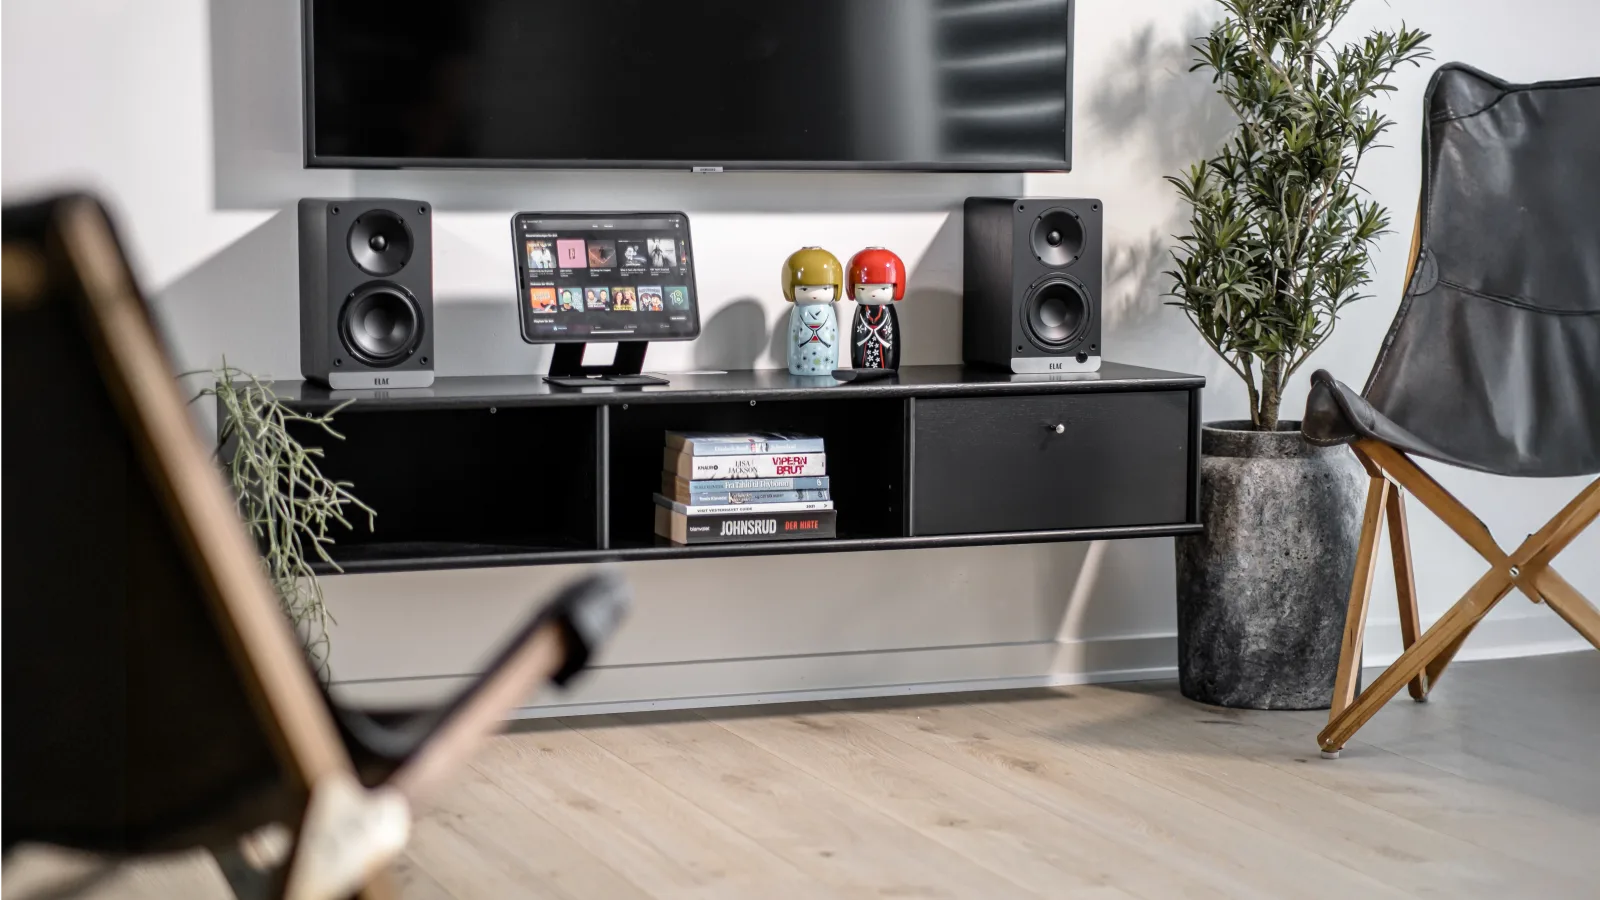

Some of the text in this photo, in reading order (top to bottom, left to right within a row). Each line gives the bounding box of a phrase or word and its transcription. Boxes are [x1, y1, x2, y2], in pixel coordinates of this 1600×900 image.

[1049, 362, 1063, 370] ELAC
[772, 456, 808, 465] VIPERN
[728, 466, 758, 474] JACKSON
[776, 465, 805, 475] BRUT
[725, 480, 735, 489] Fra
[720, 519, 777, 536] JOHNSRUD
[785, 521, 798, 531] DER
[799, 520, 819, 529] HIRTE
